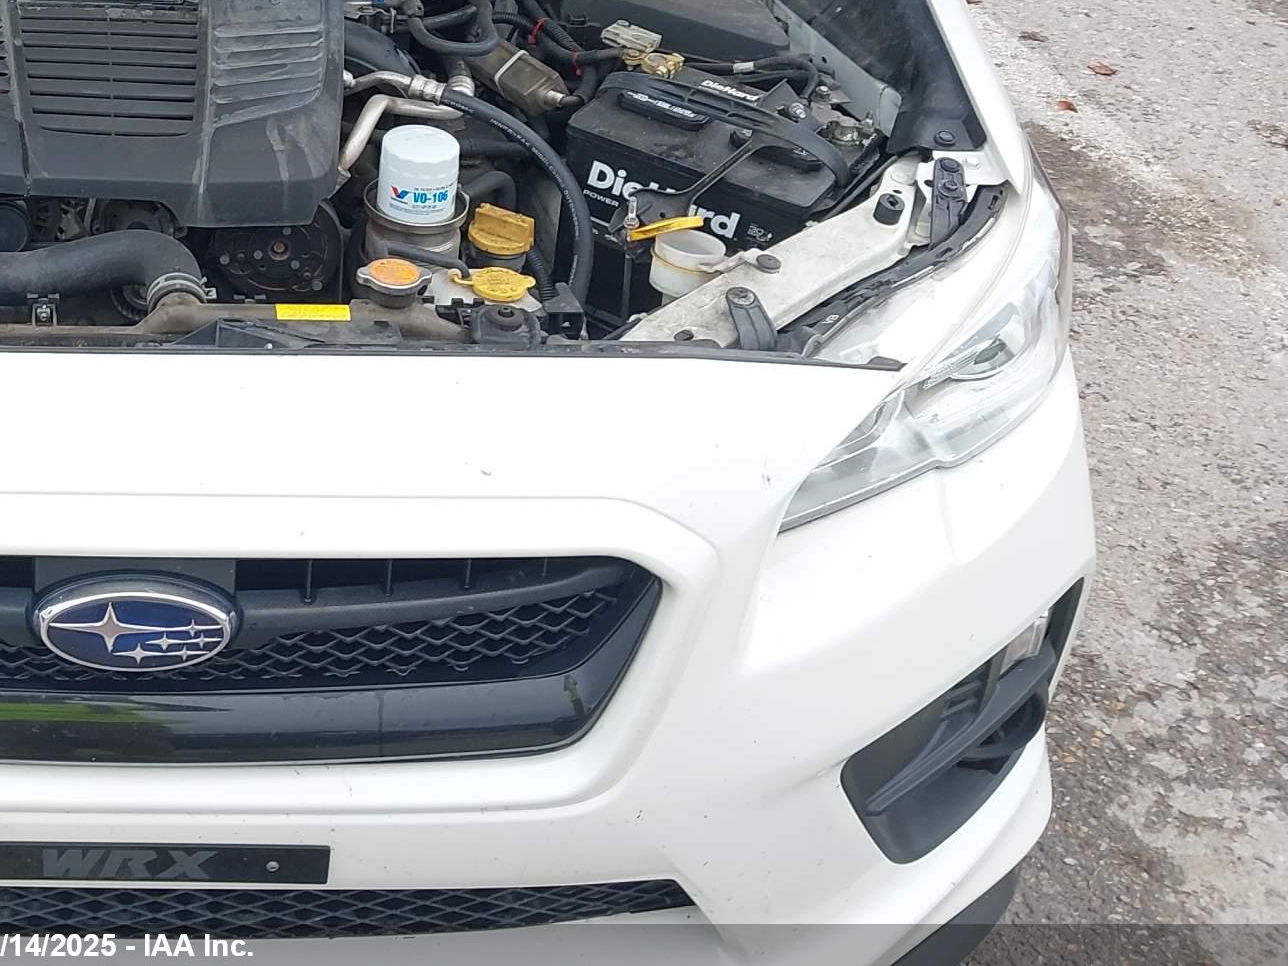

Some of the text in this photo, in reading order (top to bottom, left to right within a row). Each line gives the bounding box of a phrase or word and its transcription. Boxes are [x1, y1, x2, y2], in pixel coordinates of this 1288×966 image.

[701, 79, 760, 102] DieHard
[582, 188, 620, 208] POWER
[42, 848, 218, 879] WRX
